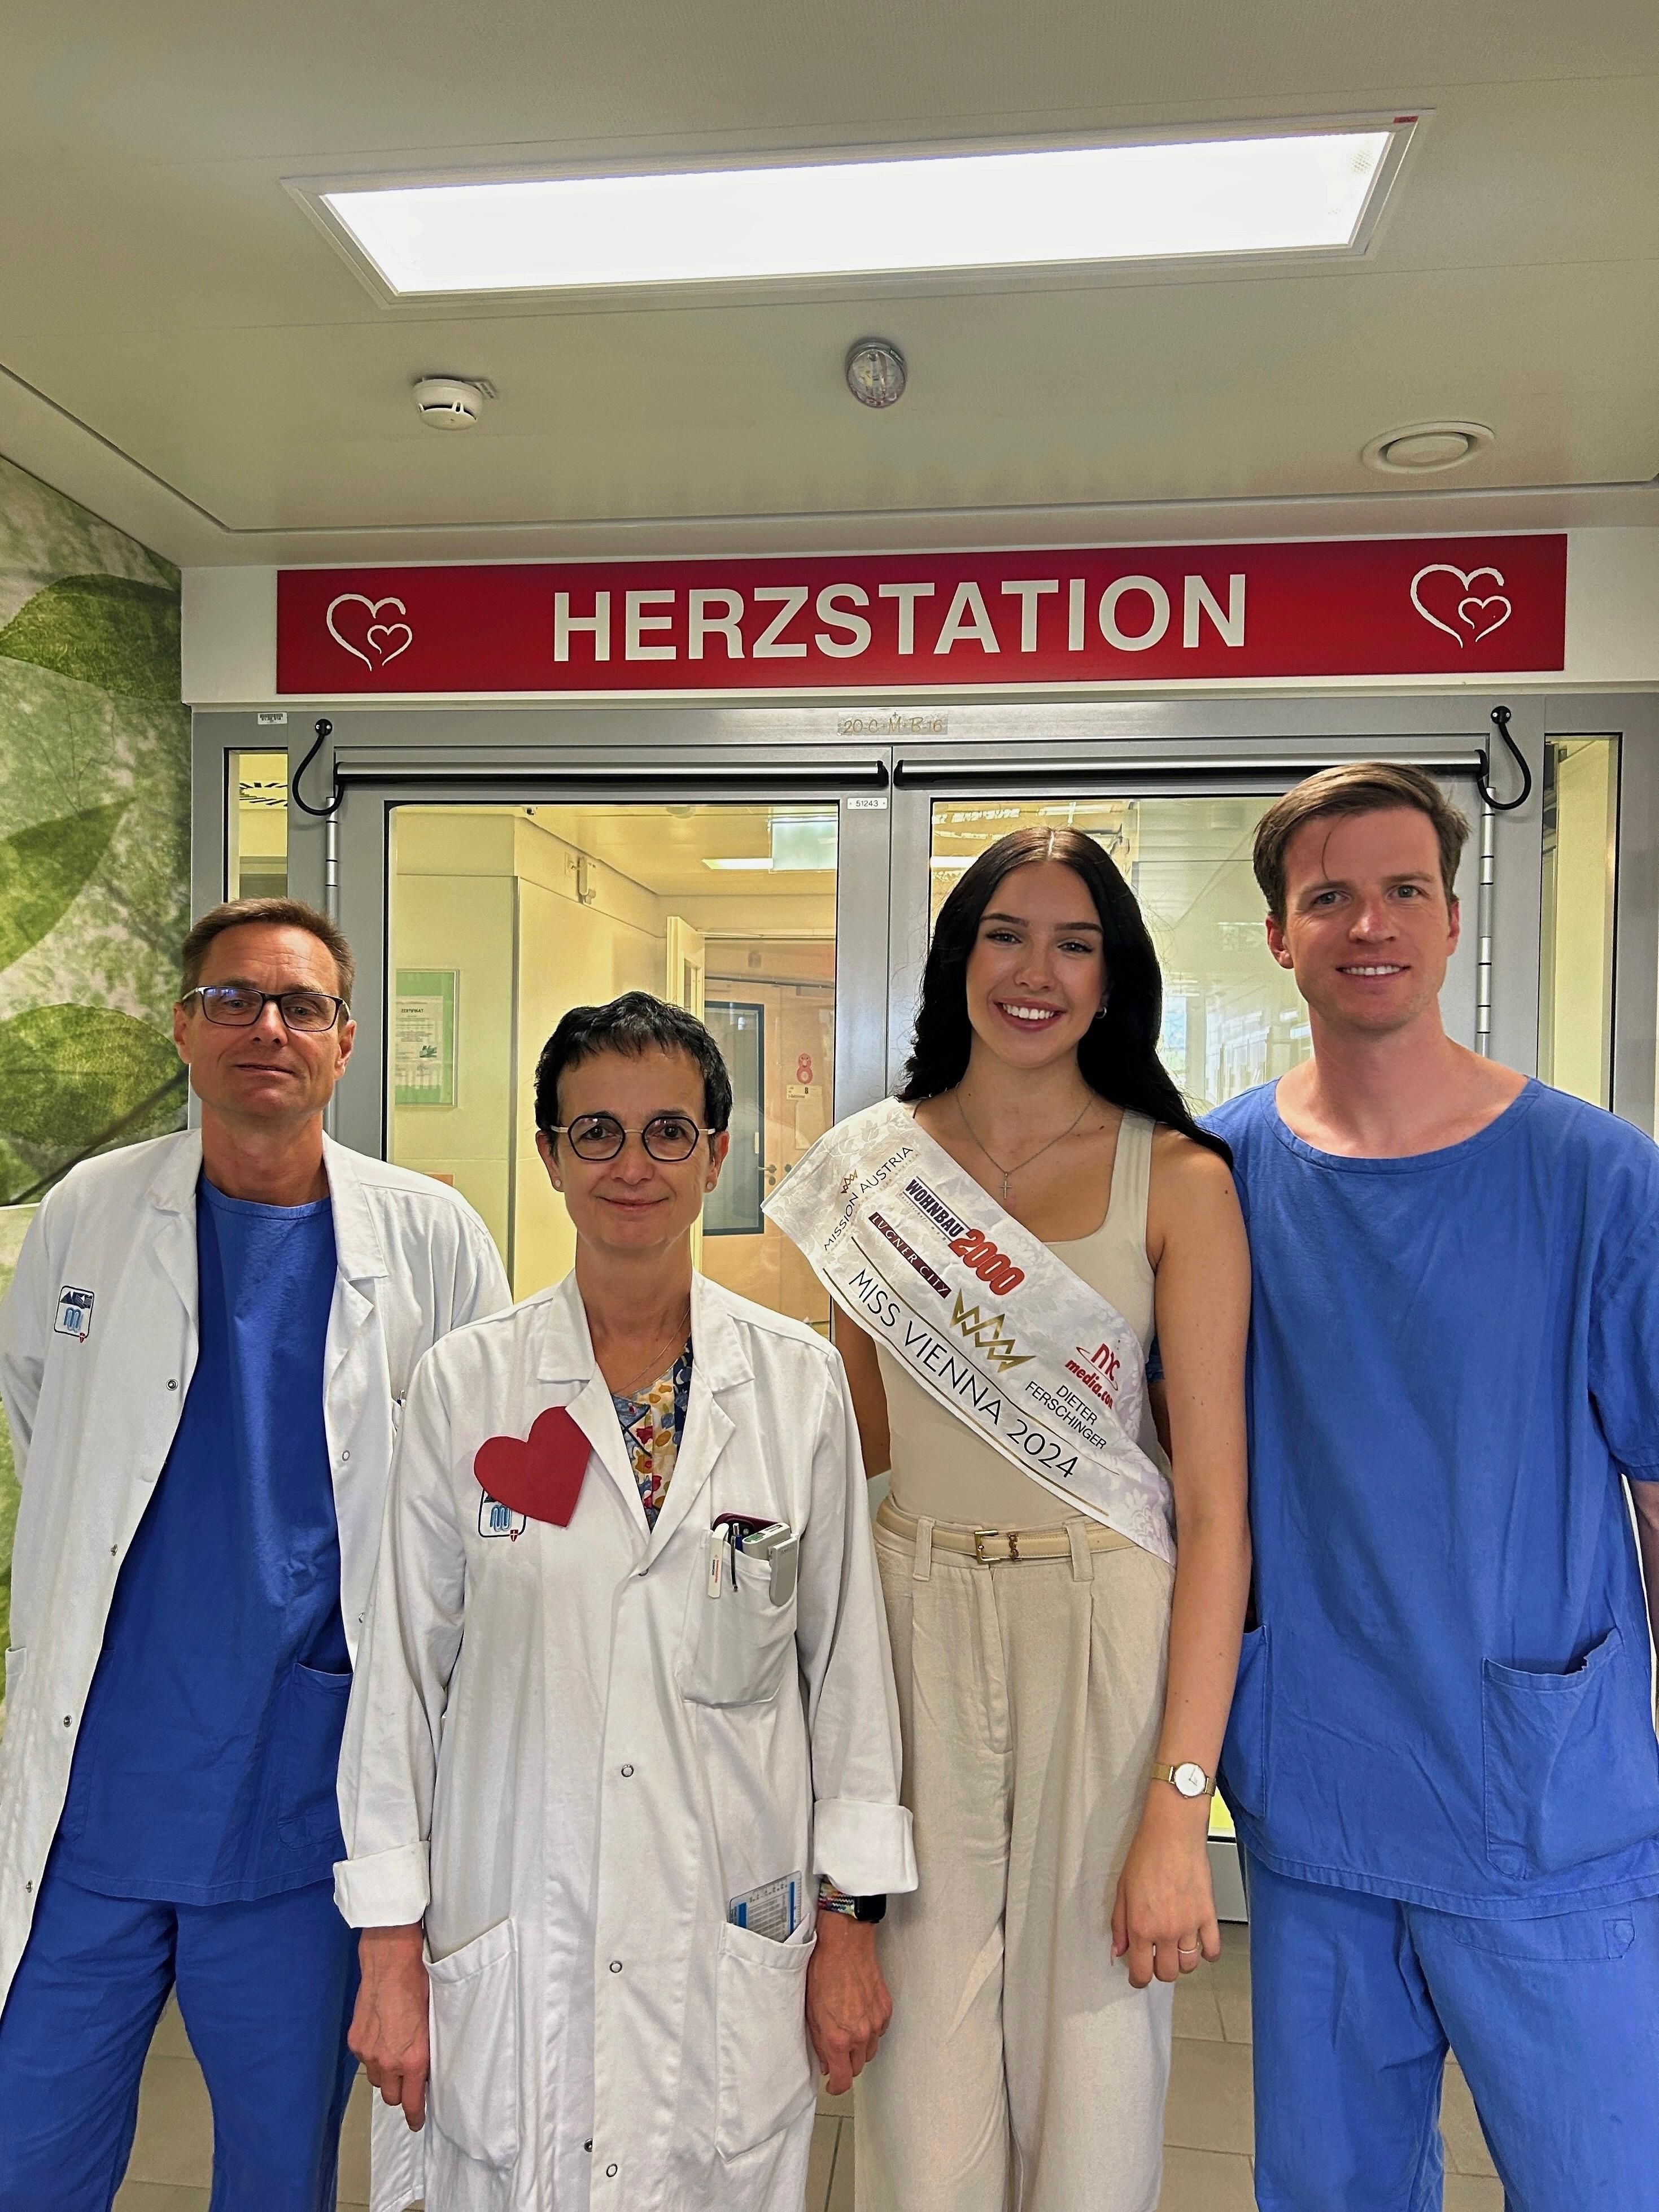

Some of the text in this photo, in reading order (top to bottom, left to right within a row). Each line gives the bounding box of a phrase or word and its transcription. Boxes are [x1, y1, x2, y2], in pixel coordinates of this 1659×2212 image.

[554, 574, 1246, 662] HERZSTATION
[824, 1192, 859, 1251] MISSION
[860, 1147, 914, 1193] AUSTRIA
[905, 1179, 965, 1238] WOHNBAU
[872, 1215, 918, 1264] LUGNER
[919, 1266, 949, 1292] CITY
[948, 1228, 1025, 1295] 2000
[848, 1268, 1079, 1478] MISS VIENNA 2024
[1056, 1384, 1098, 1426] DIETER
[1024, 1380, 1107, 1450] FERSCHINGER
